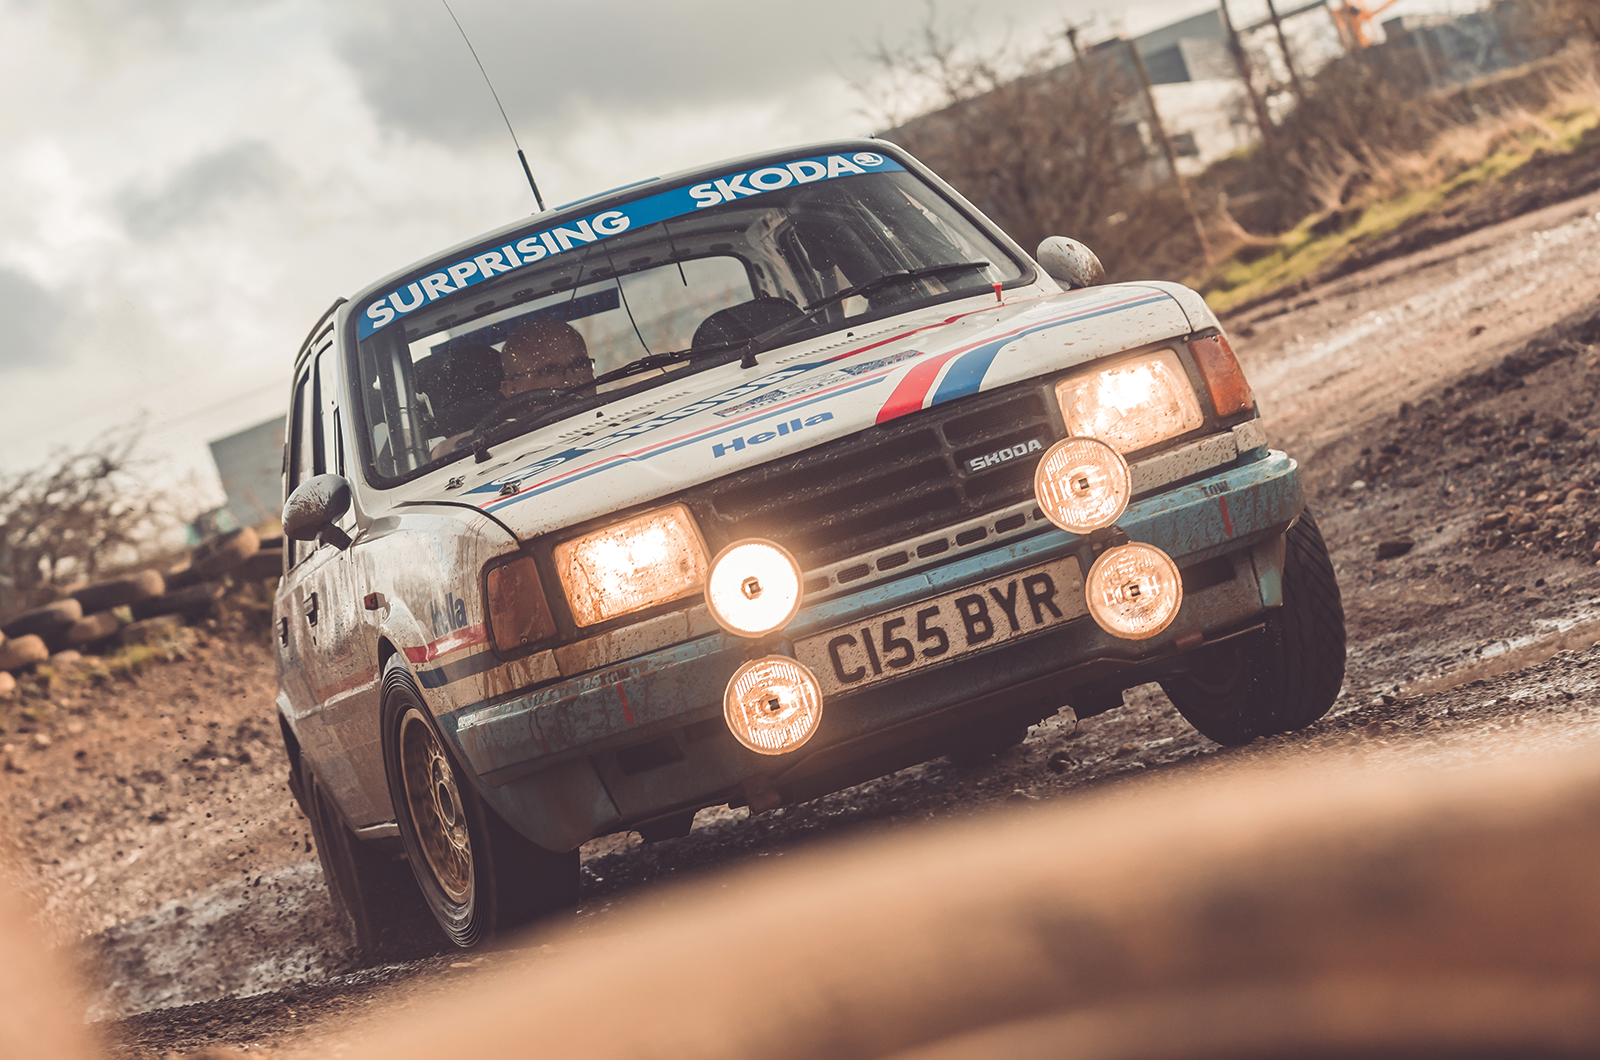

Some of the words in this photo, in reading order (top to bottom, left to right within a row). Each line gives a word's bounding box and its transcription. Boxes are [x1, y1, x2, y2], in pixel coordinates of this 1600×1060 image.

[366, 210, 631, 329] SURPRISING
[688, 155, 867, 208] SKODA
[712, 410, 834, 459] Hella
[969, 439, 1043, 472] SKODA
[827, 605, 950, 685] C155
[954, 572, 1064, 647] BYR
